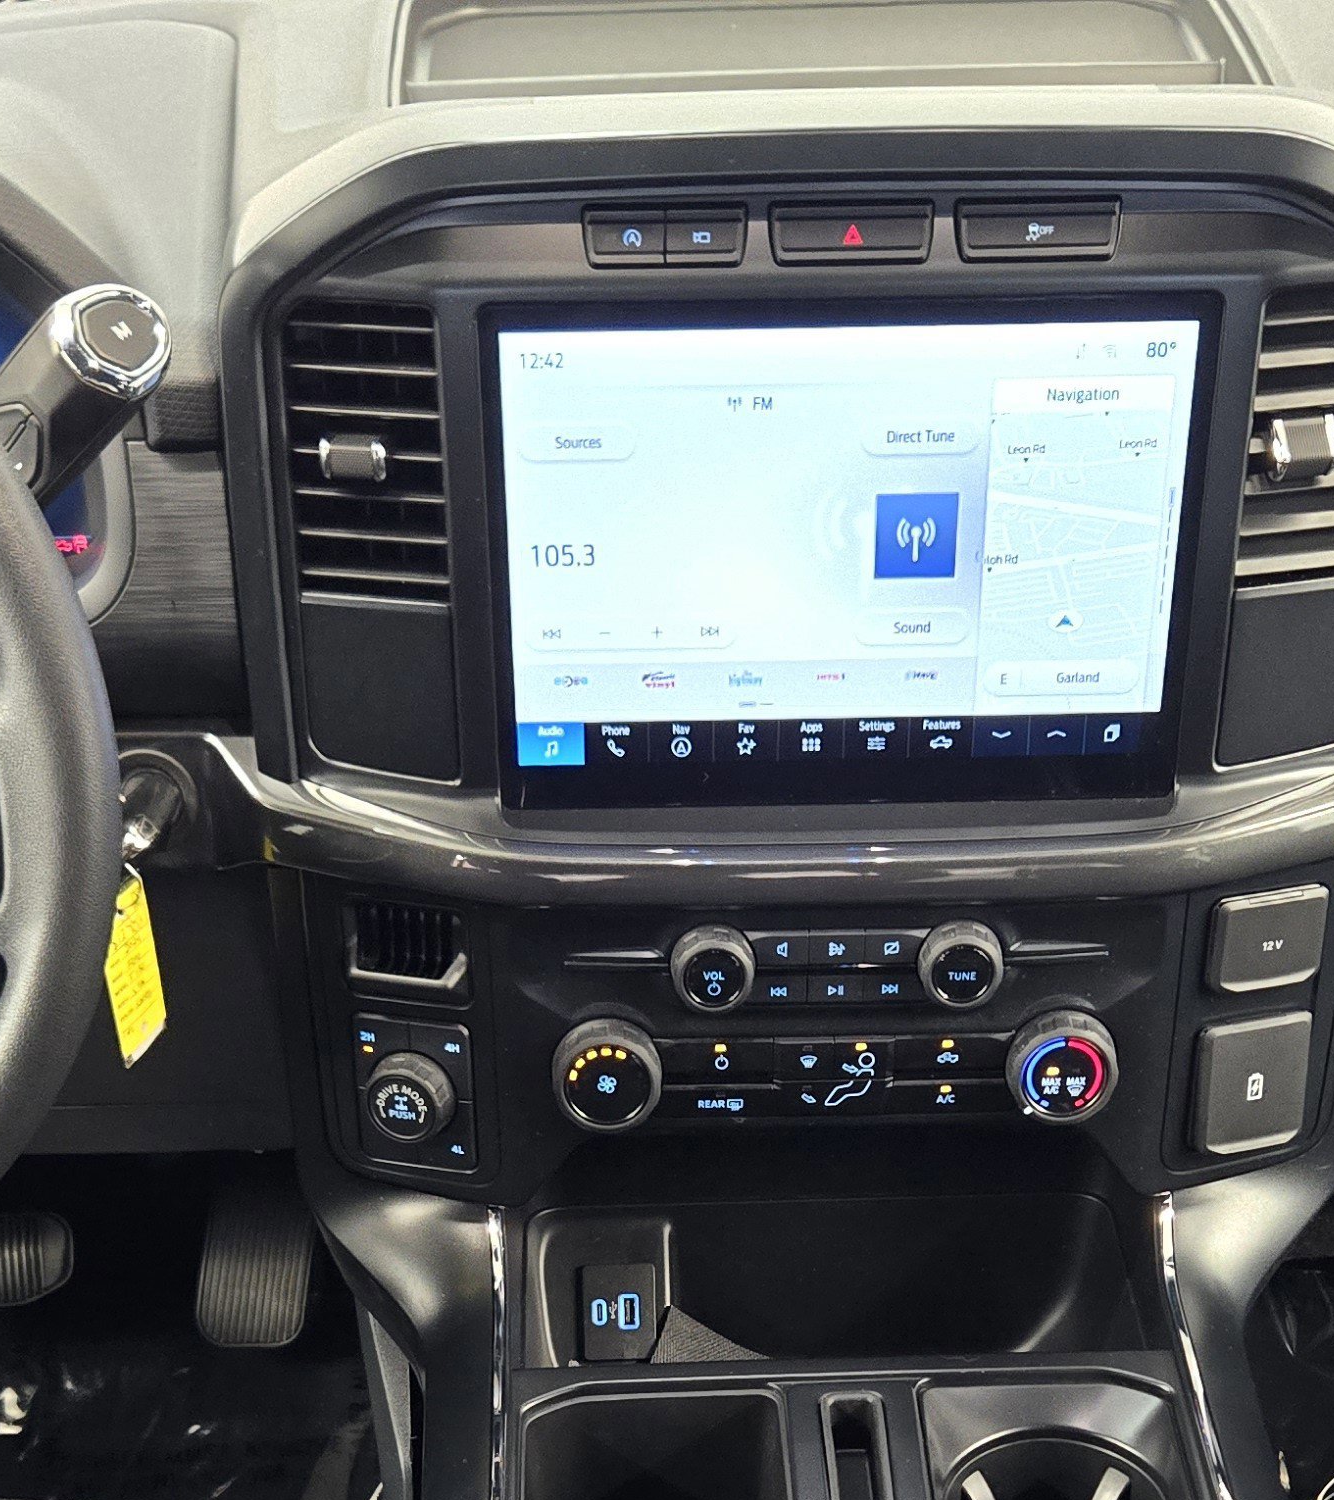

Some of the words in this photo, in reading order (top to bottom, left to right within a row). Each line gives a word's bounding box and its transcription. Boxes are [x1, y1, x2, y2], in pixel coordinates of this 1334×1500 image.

[1039, 225, 1055, 235] OFF
[520, 352, 564, 369] 12:42
[1046, 387, 1120, 404] Navigation
[752, 396, 773, 411] FM
[886, 429, 922, 444] Direct
[924, 428, 956, 444] Tune
[554, 436, 602, 450] Sources
[530, 544, 595, 567] 105.3
[893, 621, 931, 635] Sound
[1000, 673, 1008, 685] E
[1056, 671, 1100, 684] Garland
[537, 725, 565, 737] Audio
[601, 724, 631, 737] Phone
[672, 723, 691, 735] Nav
[738, 722, 756, 734] Fav
[799, 721, 824, 734] Apps
[858, 719, 896, 733] Settings
[922, 719, 961, 731] Features
[702, 970, 726, 981] VOL
[948, 970, 977, 981] TUNE
[359, 1030, 376, 1042] 2H
[444, 1042, 460, 1053] 4H
[1041, 1076, 1062, 1087] MAX
[1065, 1075, 1087, 1086] MAX
[1043, 1086, 1060, 1095] A/C
[375, 1083, 400, 1107] DRIVE
[401, 1084, 428, 1113] MODE
[697, 1099, 726, 1109] REAR
[935, 1094, 956, 1104] A/C
[388, 1108, 417, 1121] PUSH
[450, 1144, 465, 1155] 4L
